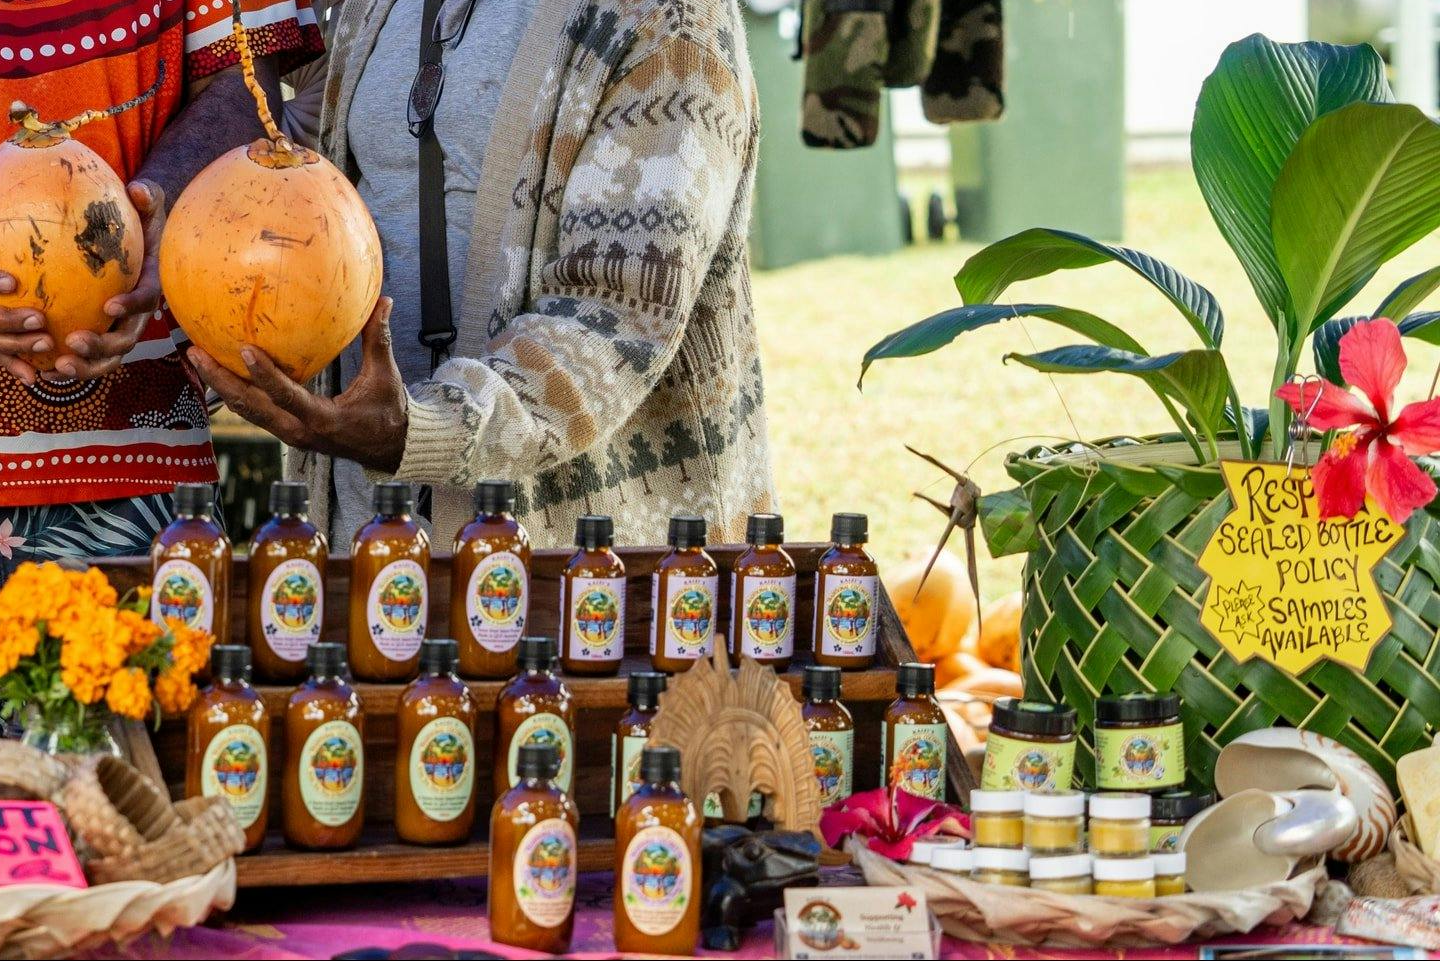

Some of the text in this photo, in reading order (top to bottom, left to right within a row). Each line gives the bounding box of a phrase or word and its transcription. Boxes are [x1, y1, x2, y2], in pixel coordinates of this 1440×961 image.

[1217, 517, 1394, 559] SEALED BOTTLE
[1276, 554, 1360, 592] POLICY
[1222, 593, 1256, 619] PLEASE
[1235, 611, 1255, 629] ASK
[1268, 596, 1368, 628] SAMPLES
[1260, 623, 1370, 660] AVAILABLE
